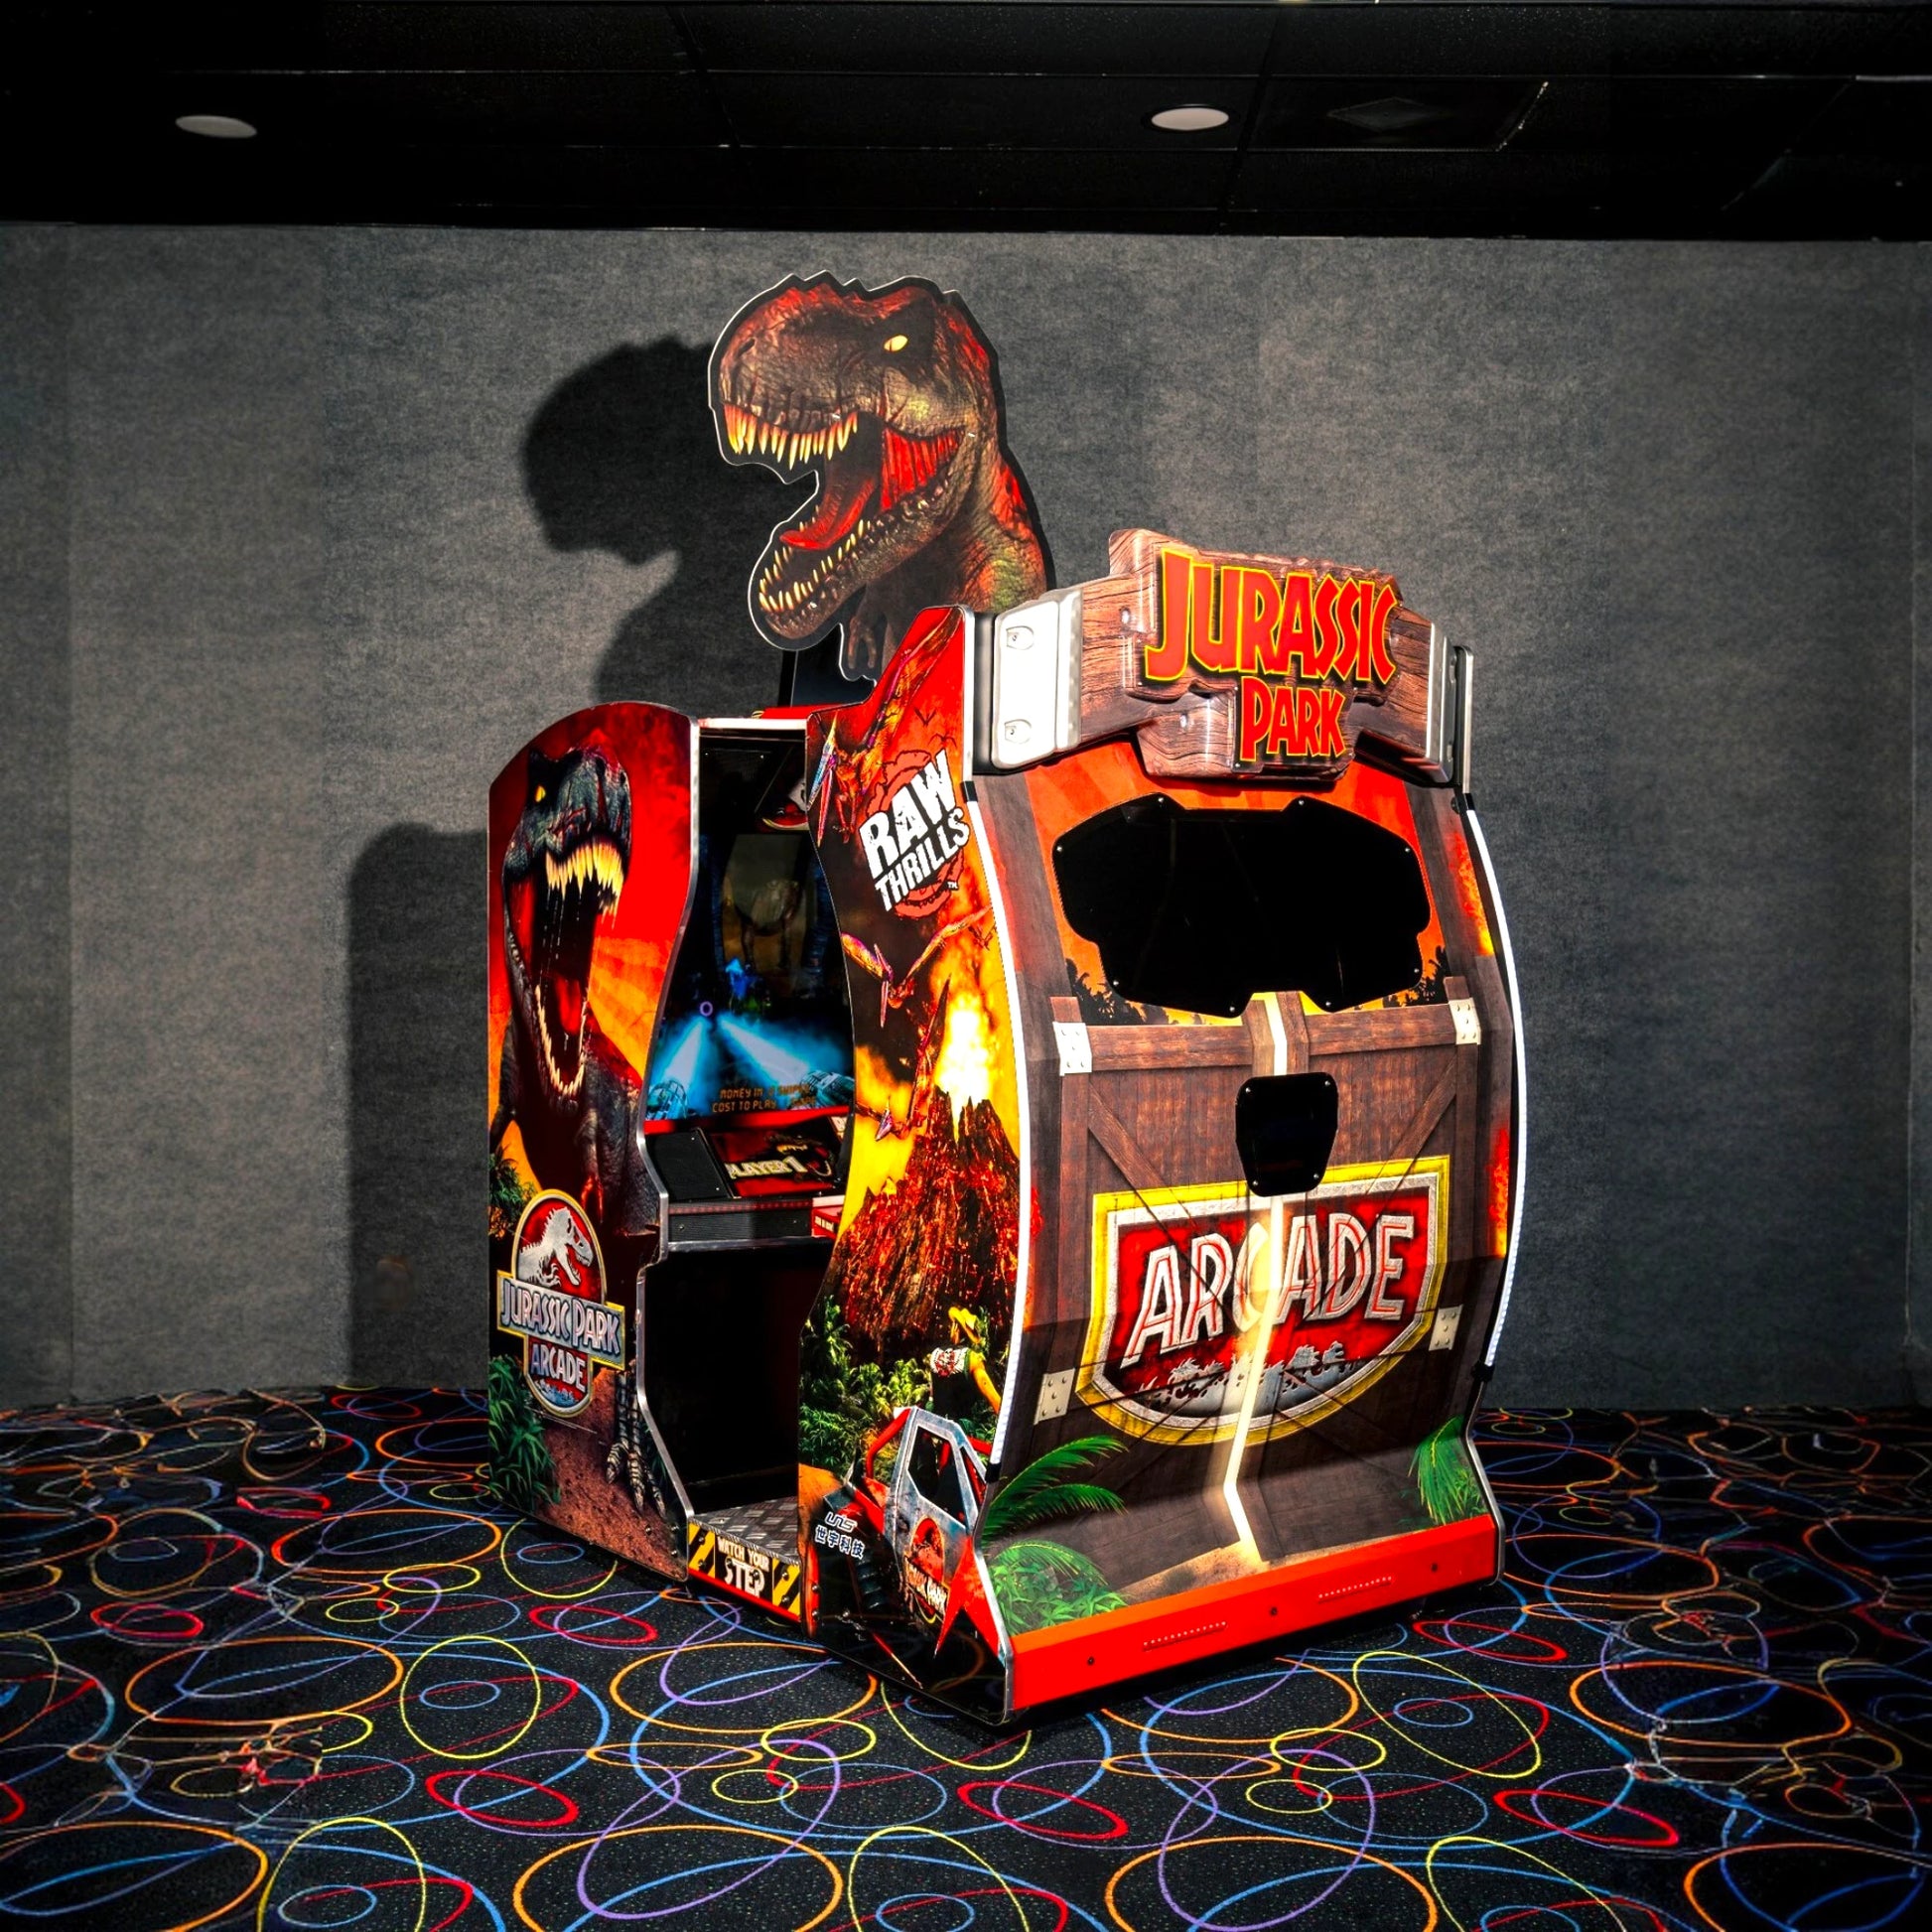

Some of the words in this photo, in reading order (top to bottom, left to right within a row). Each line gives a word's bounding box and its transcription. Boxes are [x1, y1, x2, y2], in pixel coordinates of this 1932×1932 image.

[1145, 548, 1397, 684] JURASSIC
[1239, 676, 1349, 761] PARK
[859, 749, 956, 880] RAW
[875, 807, 970, 911] THRILLS
[712, 1102, 735, 1113] COST
[739, 1100, 751, 1111] TO
[753, 1099, 776, 1110] PLAY
[501, 1279, 571, 1339] JURASSIC
[571, 1298, 621, 1355] PARK
[1120, 1213, 1414, 1369] ARCADE
[531, 1342, 587, 1393] ARCADE
[717, 1536, 745, 1562] WATCH
[748, 1548, 769, 1573] YOUR
[725, 1556, 765, 1598] STEP
